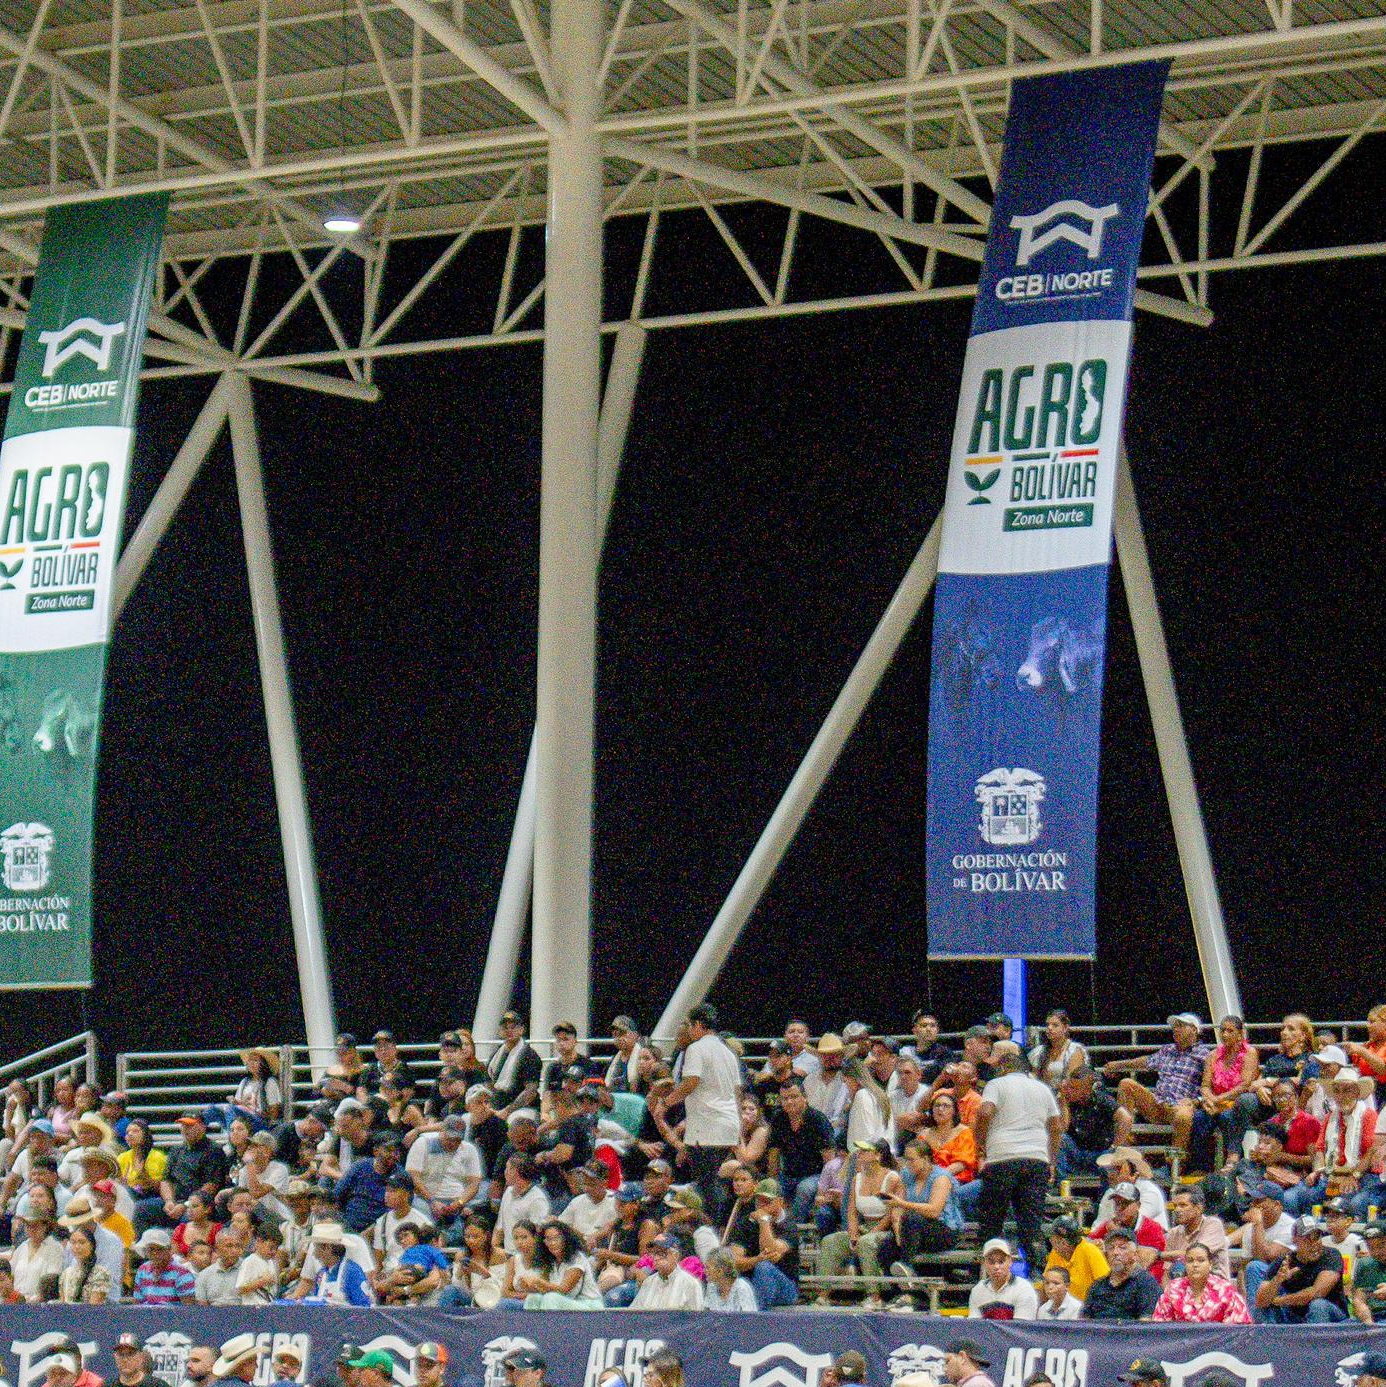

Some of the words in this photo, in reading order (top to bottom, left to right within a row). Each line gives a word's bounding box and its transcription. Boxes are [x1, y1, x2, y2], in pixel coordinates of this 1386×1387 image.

[995, 274, 1044, 300] CEB
[1051, 268, 1114, 292] NORTE
[25, 384, 63, 407] CEB
[68, 381, 118, 400] NORTE
[967, 358, 1108, 454] AGRO
[1010, 453, 1098, 502] BOLÍVAR
[1012, 511, 1043, 527] Zona
[1046, 508, 1083, 524] Norte
[30, 545, 99, 588] BOLÍVAR
[31, 597, 57, 610] Zona
[58, 594, 88, 607] Norte
[952, 849, 1066, 869] GOBERNACIÓN
[953, 878, 967, 888] DE
[971, 868, 1067, 892] BOLÍVAR
